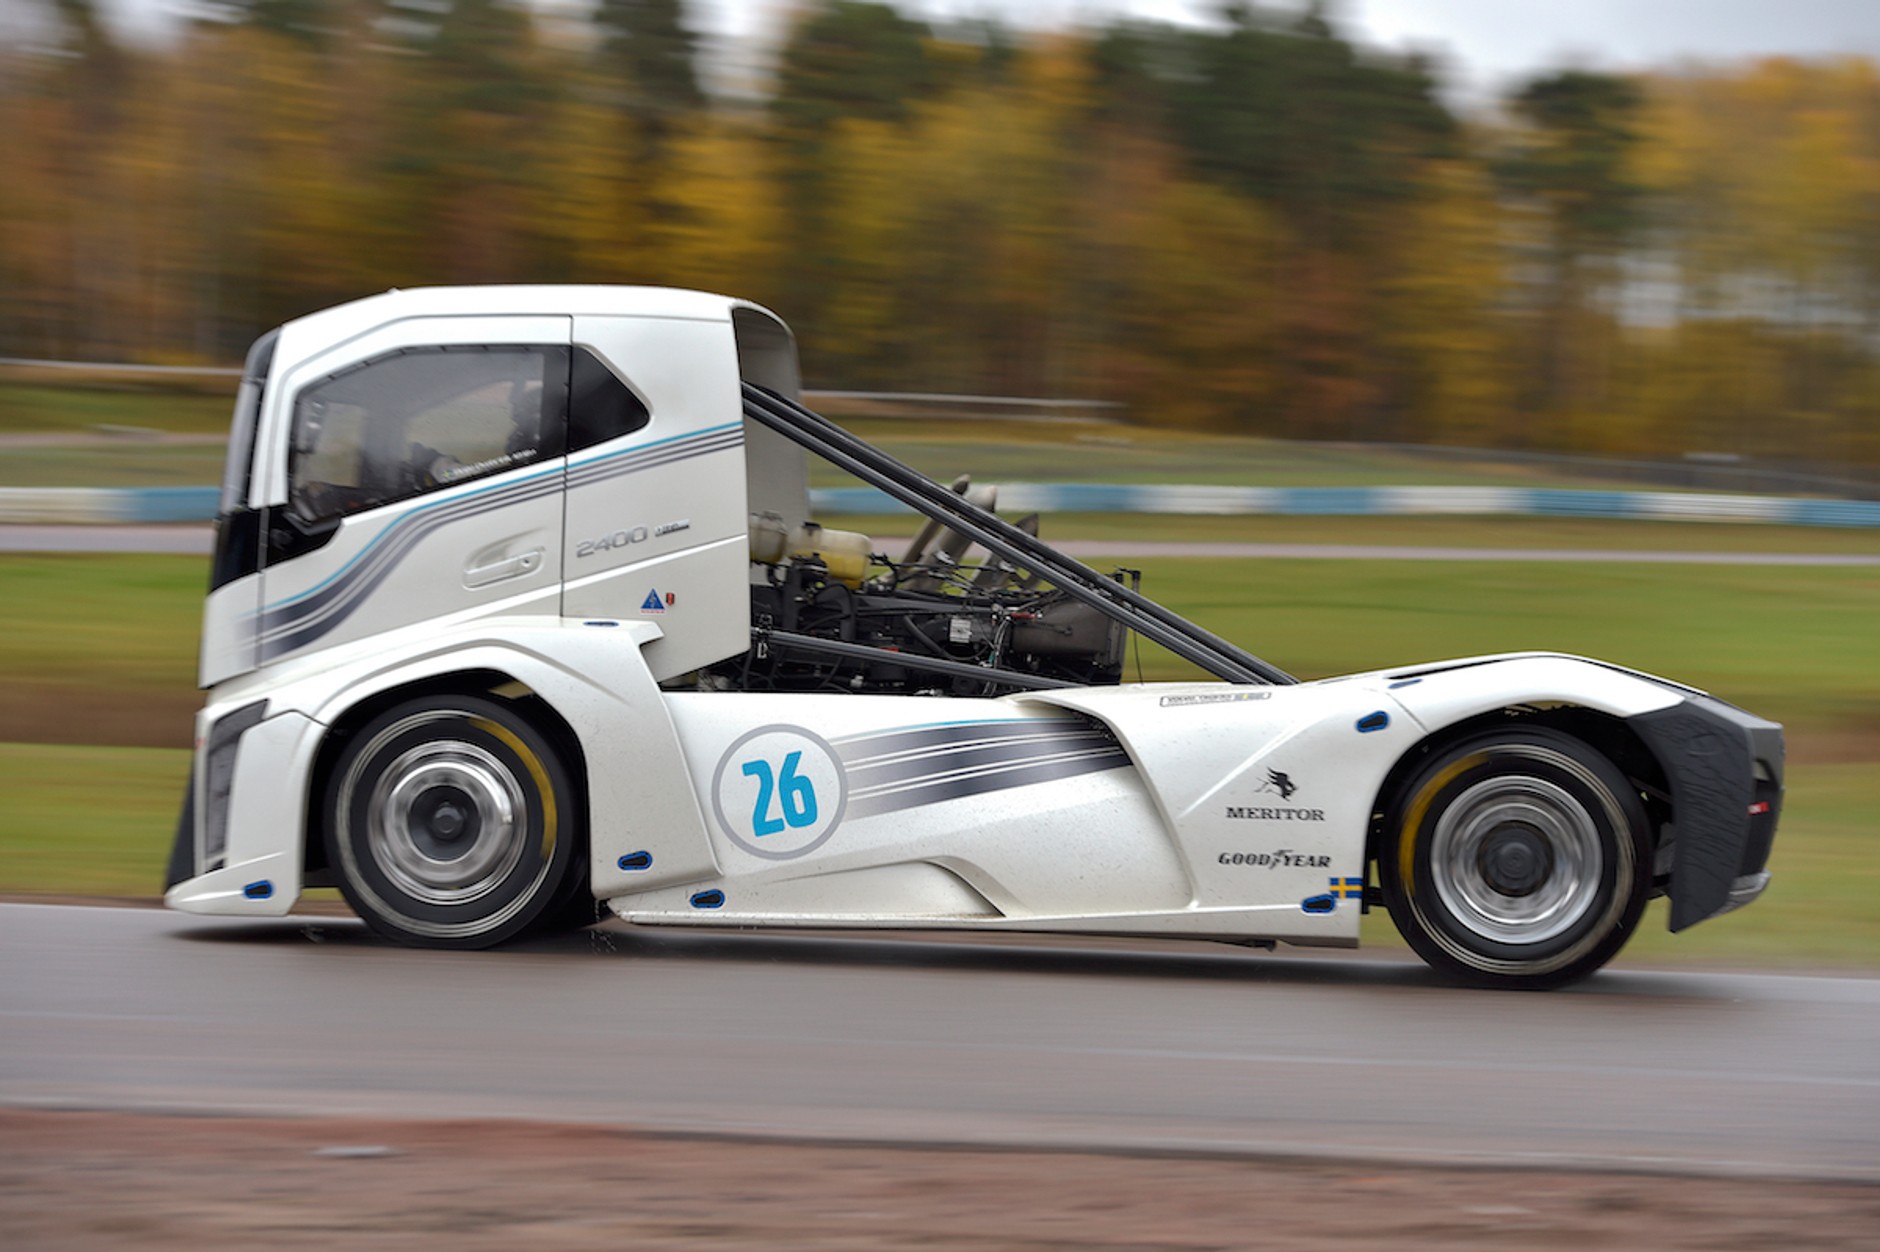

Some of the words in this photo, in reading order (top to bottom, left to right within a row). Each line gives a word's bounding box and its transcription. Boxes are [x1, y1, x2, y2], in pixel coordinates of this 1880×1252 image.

[576, 525, 648, 558] 2400
[741, 750, 818, 837] 26
[1226, 806, 1325, 821] MERITOR
[1218, 849, 1331, 869] GOODYEAR
